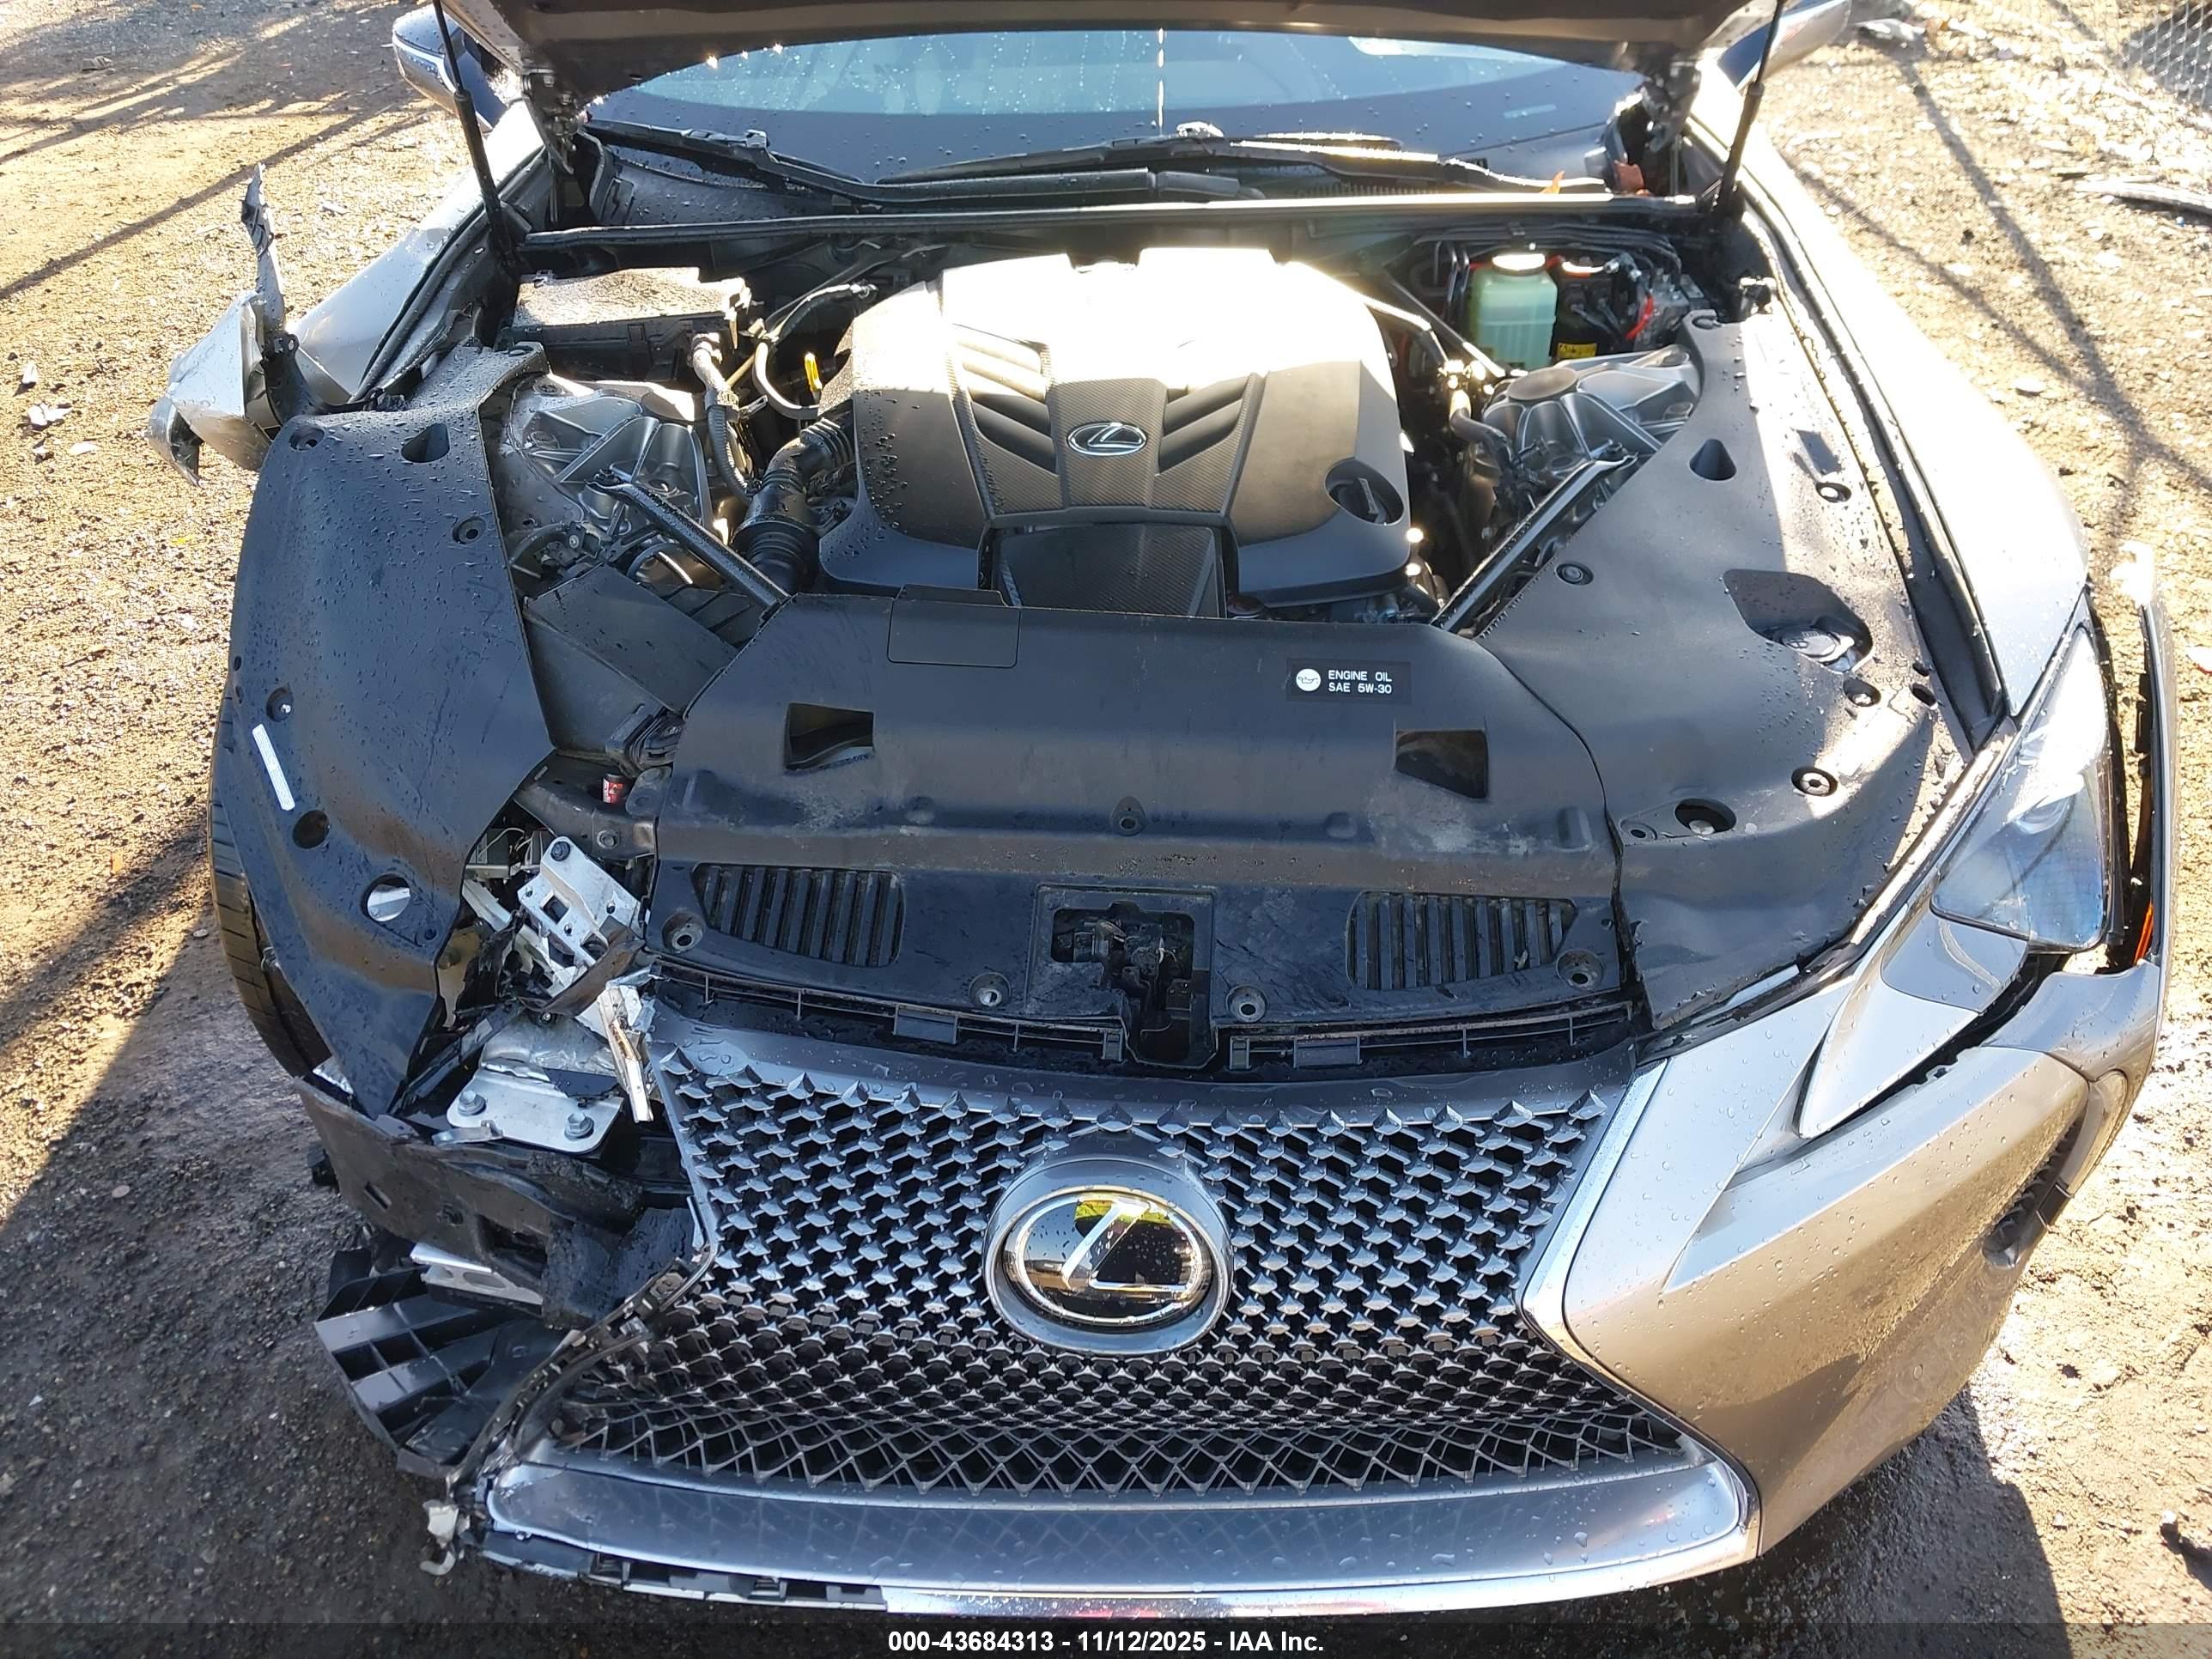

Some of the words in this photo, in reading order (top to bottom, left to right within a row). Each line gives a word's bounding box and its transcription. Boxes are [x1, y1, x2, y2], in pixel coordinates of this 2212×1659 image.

[1328, 670, 1368, 681] ENGINE
[1375, 672, 1393, 682] OIL
[1328, 682, 1351, 693] SAE
[1358, 684, 1392, 695] 5W-30
